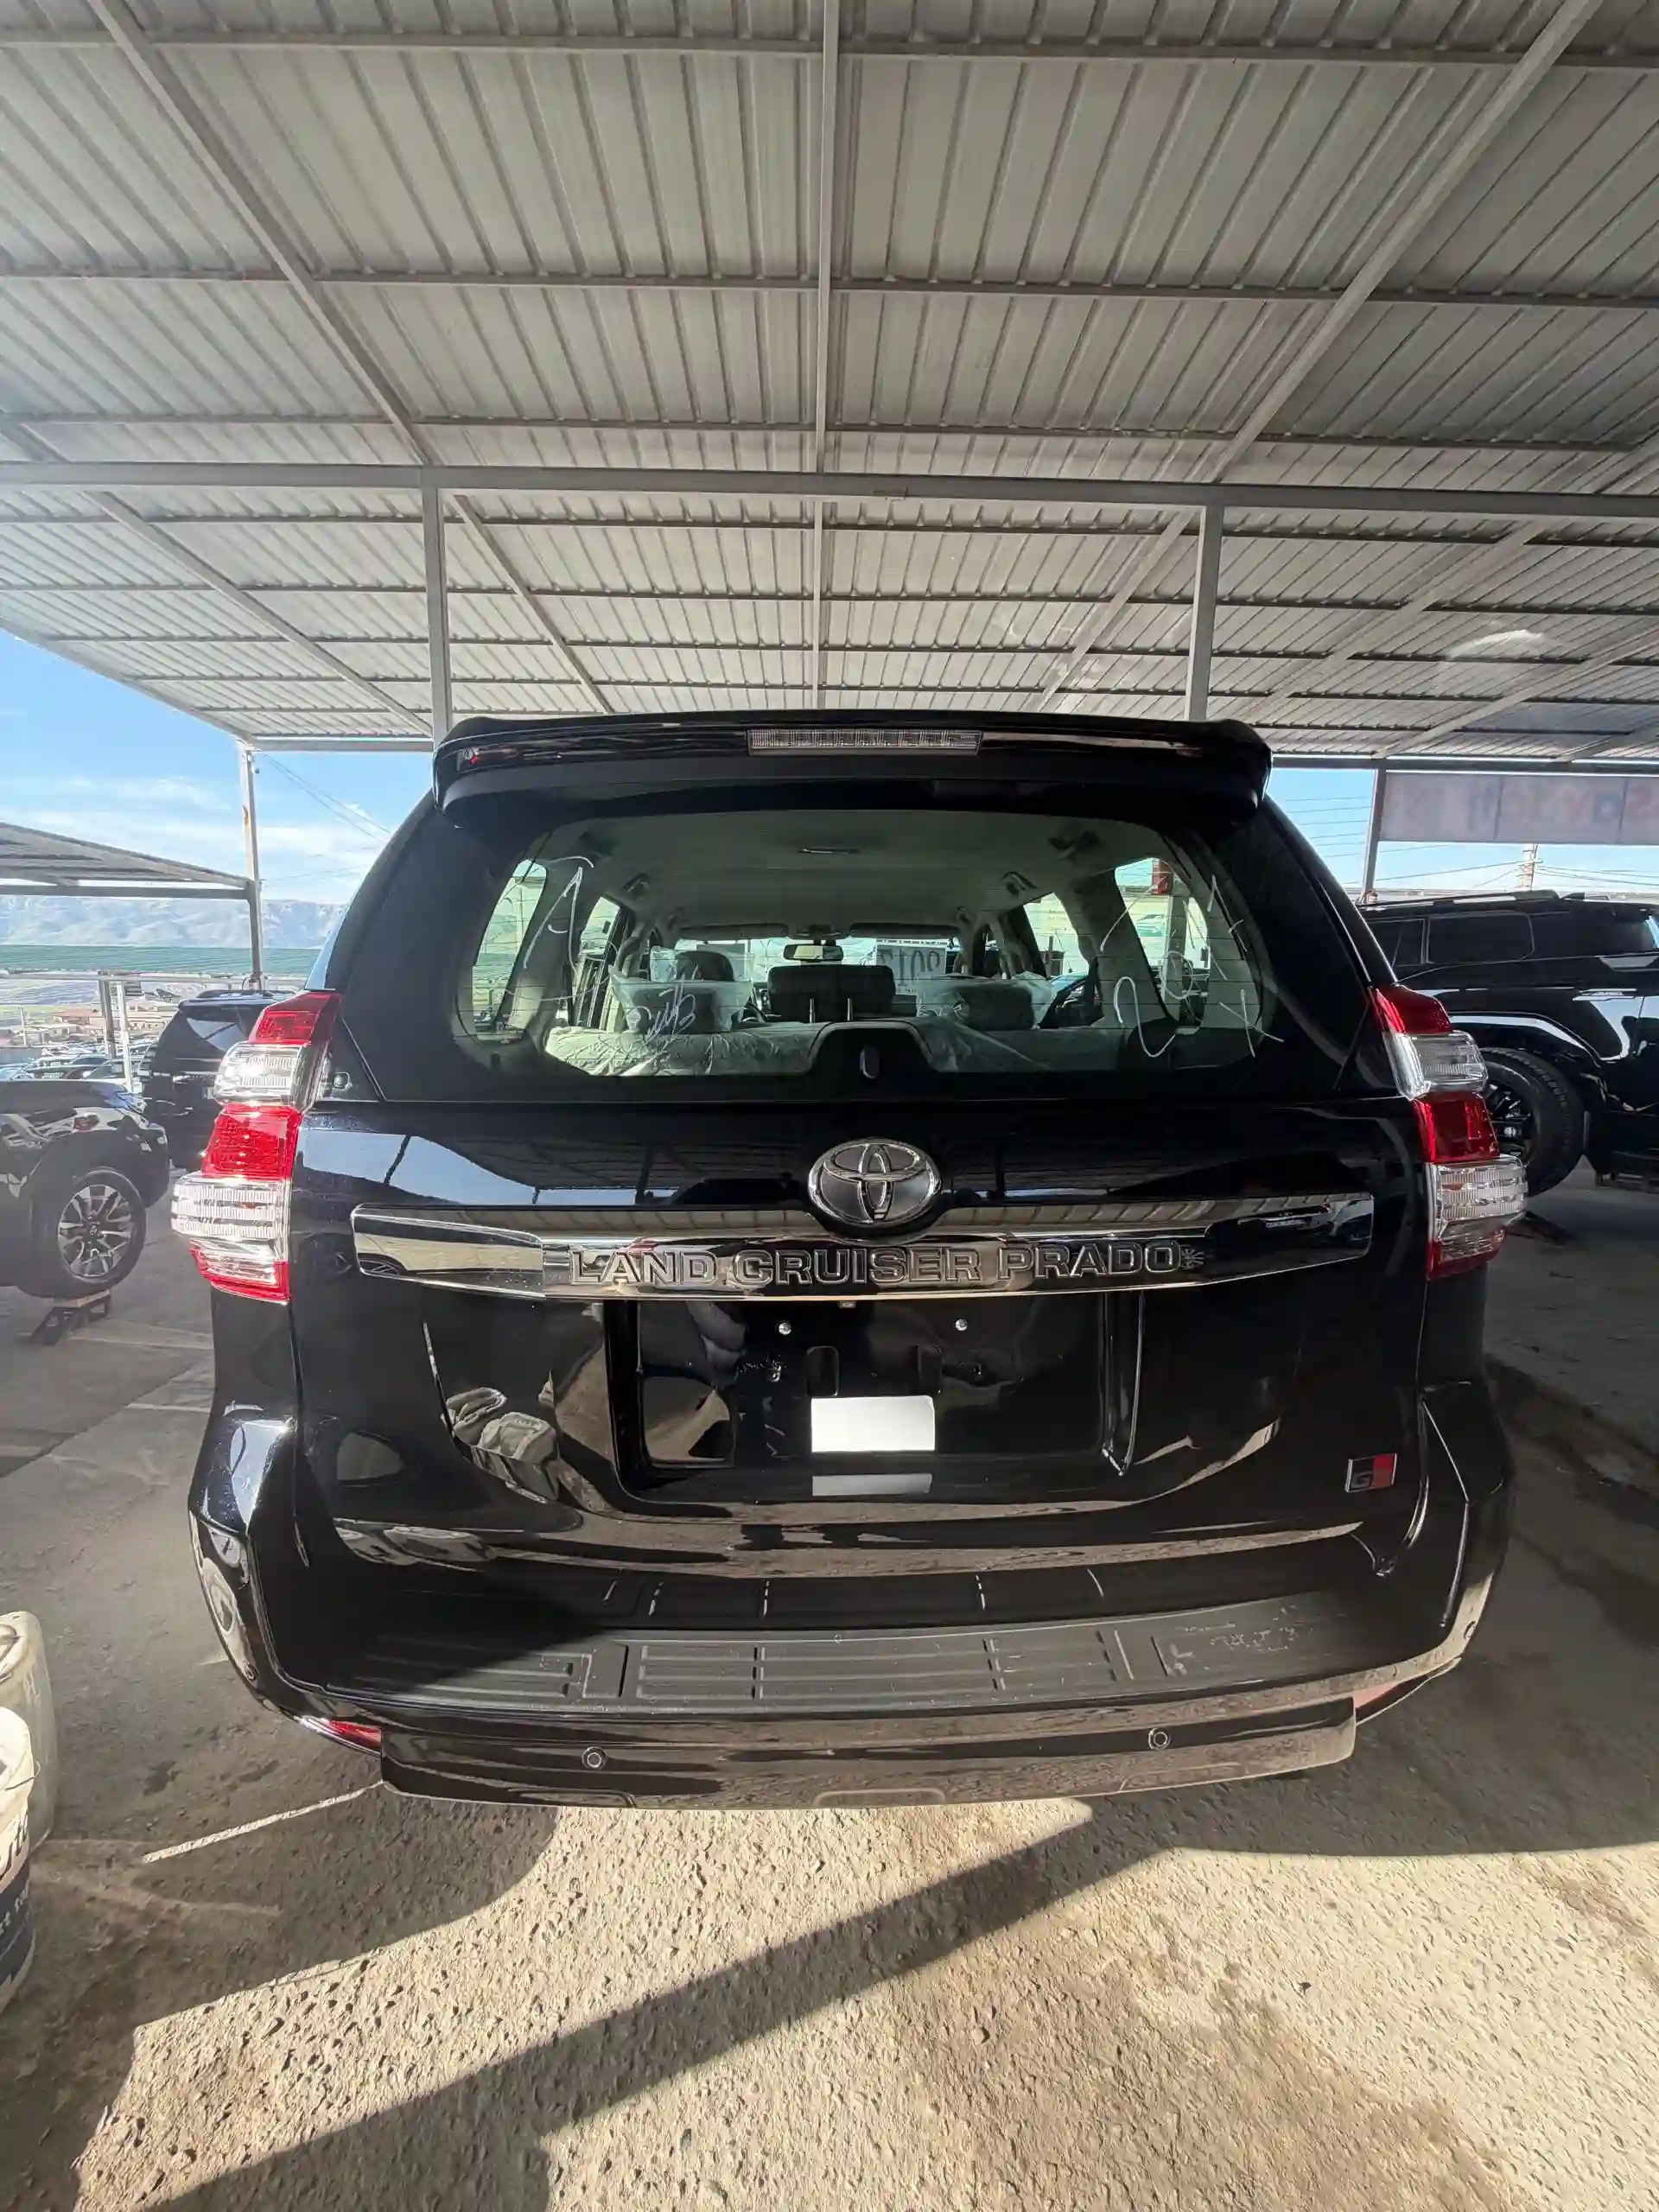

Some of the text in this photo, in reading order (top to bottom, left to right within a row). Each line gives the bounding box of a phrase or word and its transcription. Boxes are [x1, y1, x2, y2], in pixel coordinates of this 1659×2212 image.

[570, 1239, 1182, 1286] LAND CRUISER PRADO
